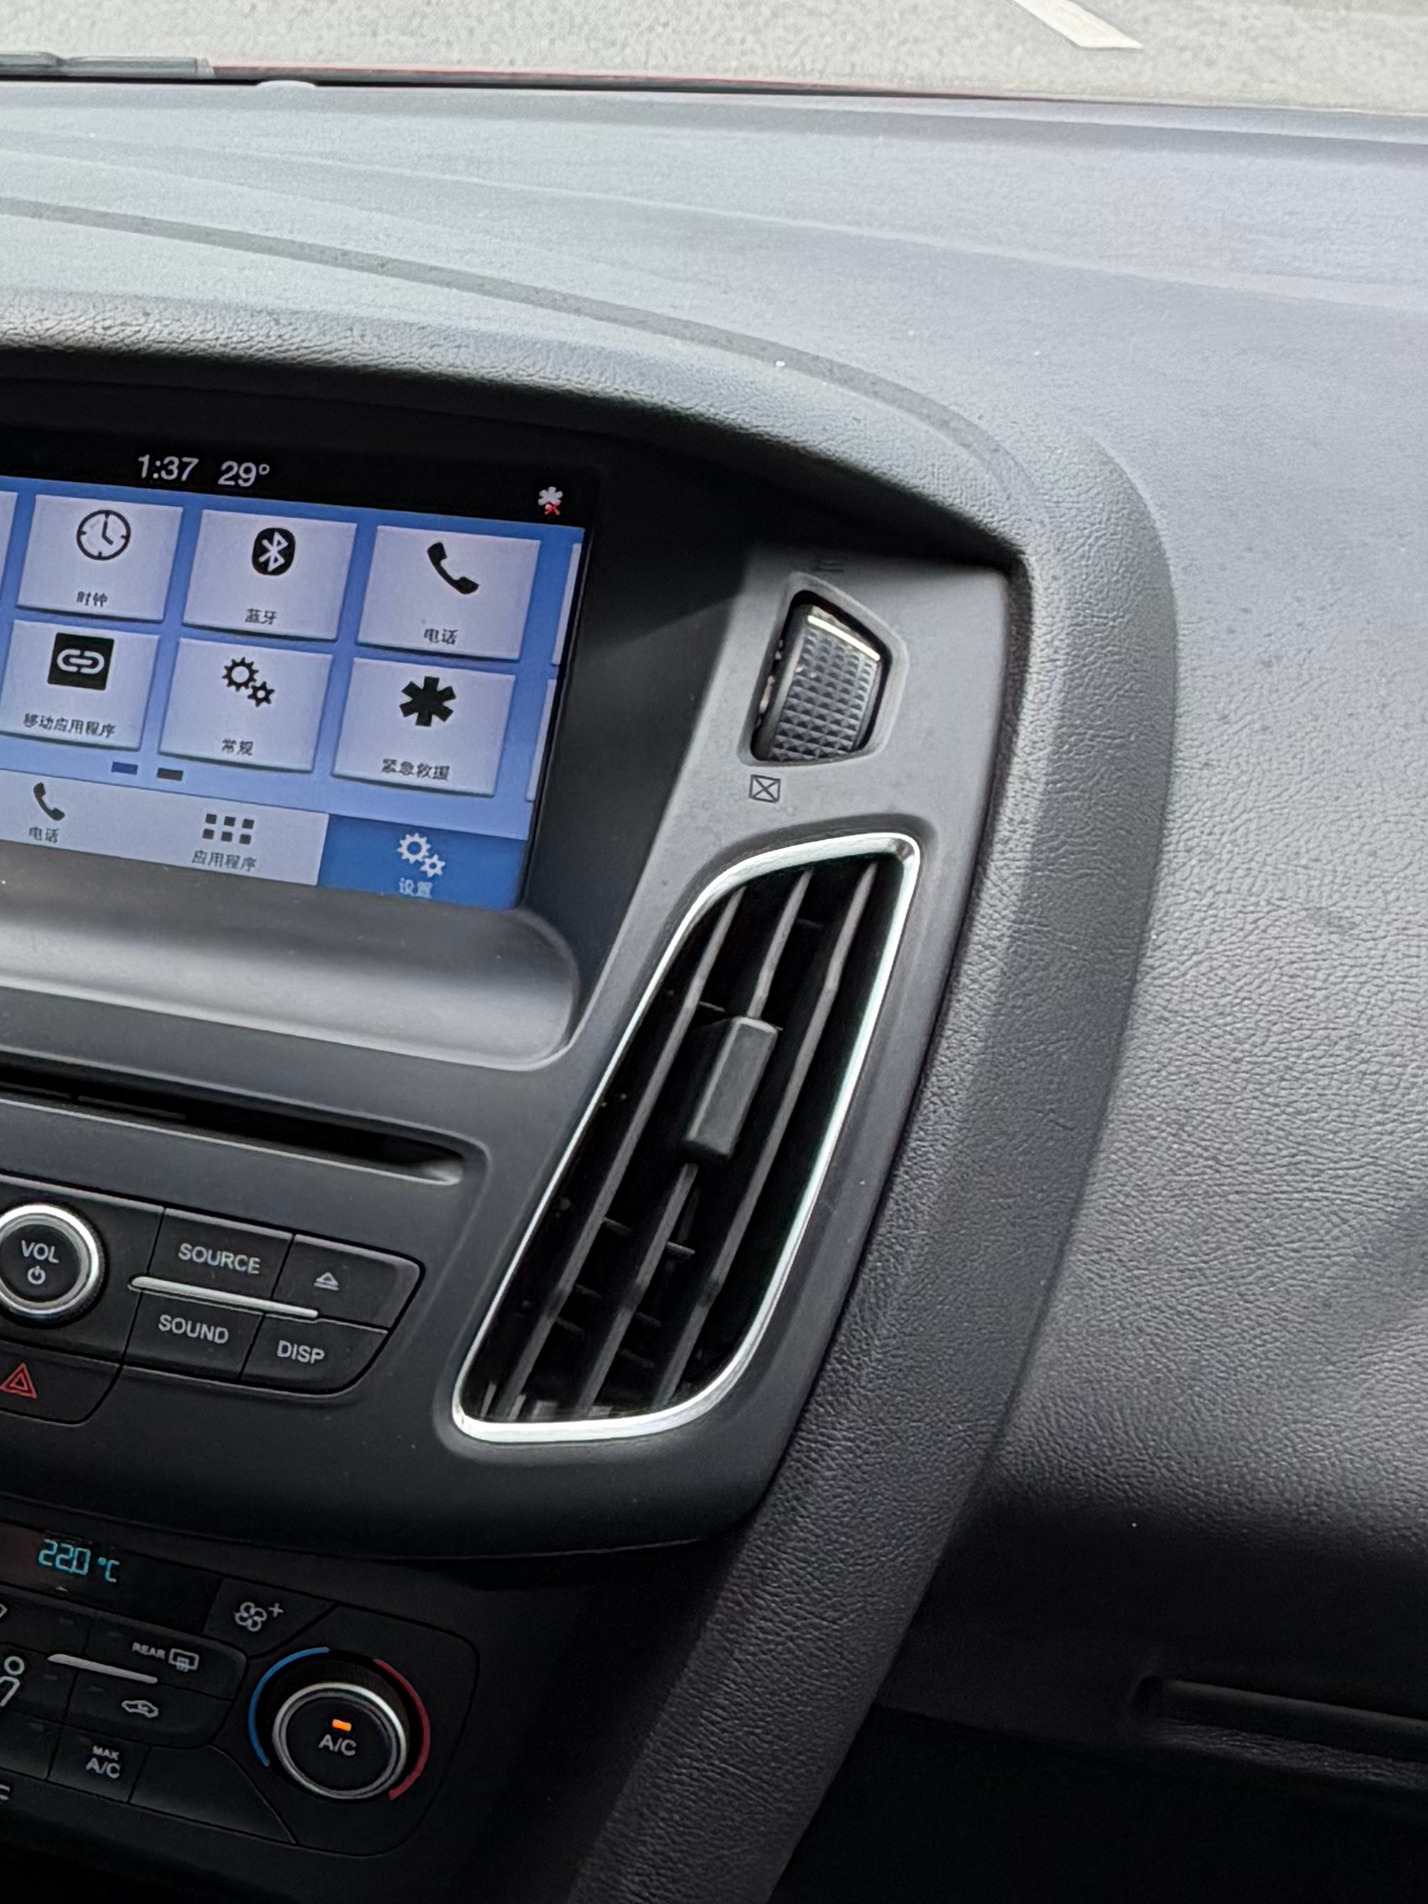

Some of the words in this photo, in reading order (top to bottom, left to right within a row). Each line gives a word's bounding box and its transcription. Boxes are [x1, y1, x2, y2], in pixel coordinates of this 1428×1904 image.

[138, 454, 199, 482] 1:37
[76, 591, 108, 608] 时钟
[244, 608, 278, 626] 蓝牙
[423, 627, 458, 646] 电话
[23, 712, 116, 739] 移动应用程序
[221, 738, 254, 756] 常规
[28, 826, 60, 844] 电话
[191, 849, 257, 872] 应用程序
[398, 877, 434, 899] 设置
[21, 1240, 59, 1264] VOL
[178, 1242, 262, 1275] SOURCE
[158, 1314, 229, 1345] SOUND
[276, 1340, 325, 1366] DISP
[132, 1642, 166, 1660] REAR
[92, 1745, 120, 1761] MAX
[318, 1734, 357, 1756] A/C
[86, 1757, 121, 1779] A/C
